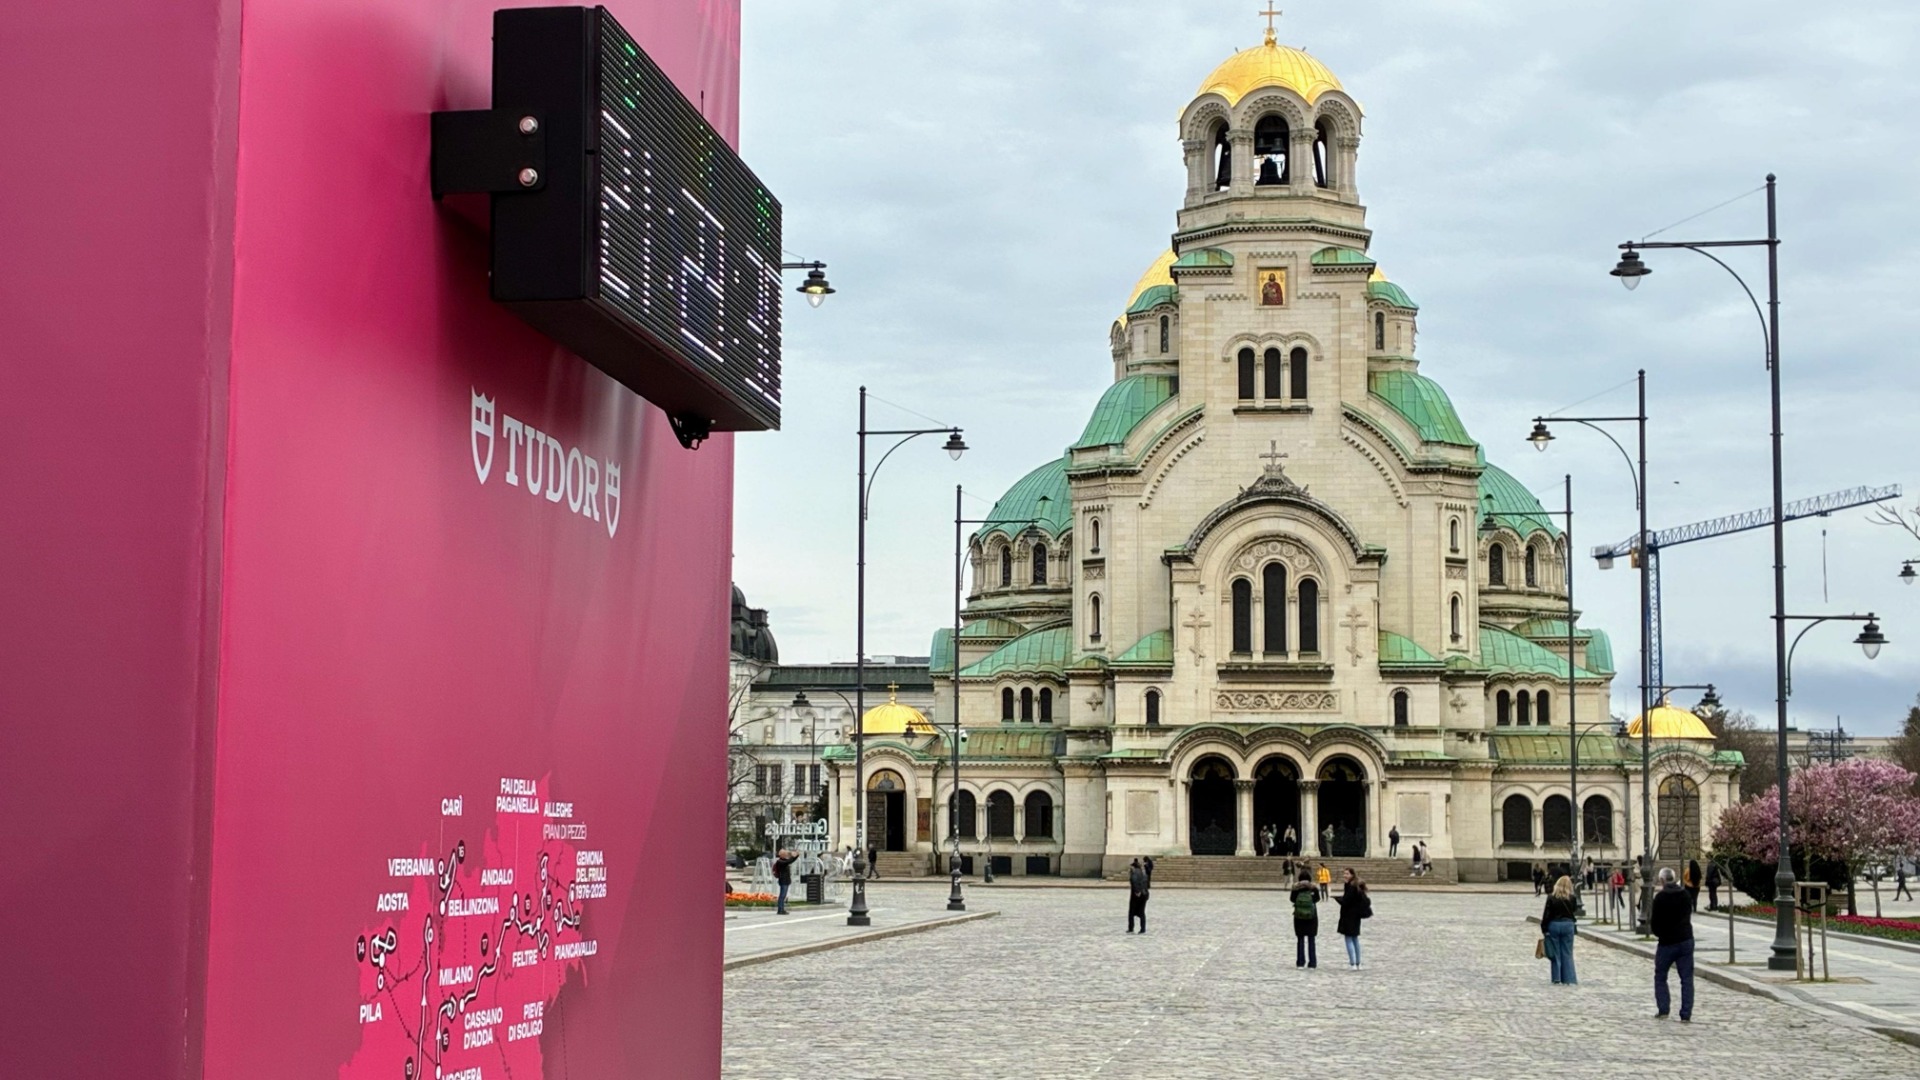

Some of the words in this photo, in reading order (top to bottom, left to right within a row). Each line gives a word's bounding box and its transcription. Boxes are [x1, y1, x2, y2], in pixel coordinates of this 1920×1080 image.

[502, 413, 600, 523] TUDOR
[500, 777, 513, 795] FAI
[513, 778, 537, 796] DELLA
[441, 795, 463, 817] CARÌ
[496, 795, 540, 814] PAGANELLA
[543, 801, 574, 818] ALLEGHE
[388, 858, 435, 877] VERBANIA
[576, 850, 604, 866] GEMONA
[481, 868, 514, 887] ANDALO
[576, 867, 588, 883] DEL
[575, 882, 607, 900] 1976-2026
[376, 892, 410, 913] AOSTA
[447, 897, 500, 917] BELLINZONA
[512, 948, 539, 968] FELTRE
[554, 939, 598, 960] PIANCAVALLO
[439, 965, 474, 987] MILANO
[359, 1002, 383, 1024] PILA
[463, 1006, 504, 1030] CASSANO
[523, 1000, 544, 1021] PIEVE
[463, 1028, 494, 1050] D'ADDA
[508, 1024, 517, 1042] DI
[516, 1018, 543, 1040] SOLIGO
